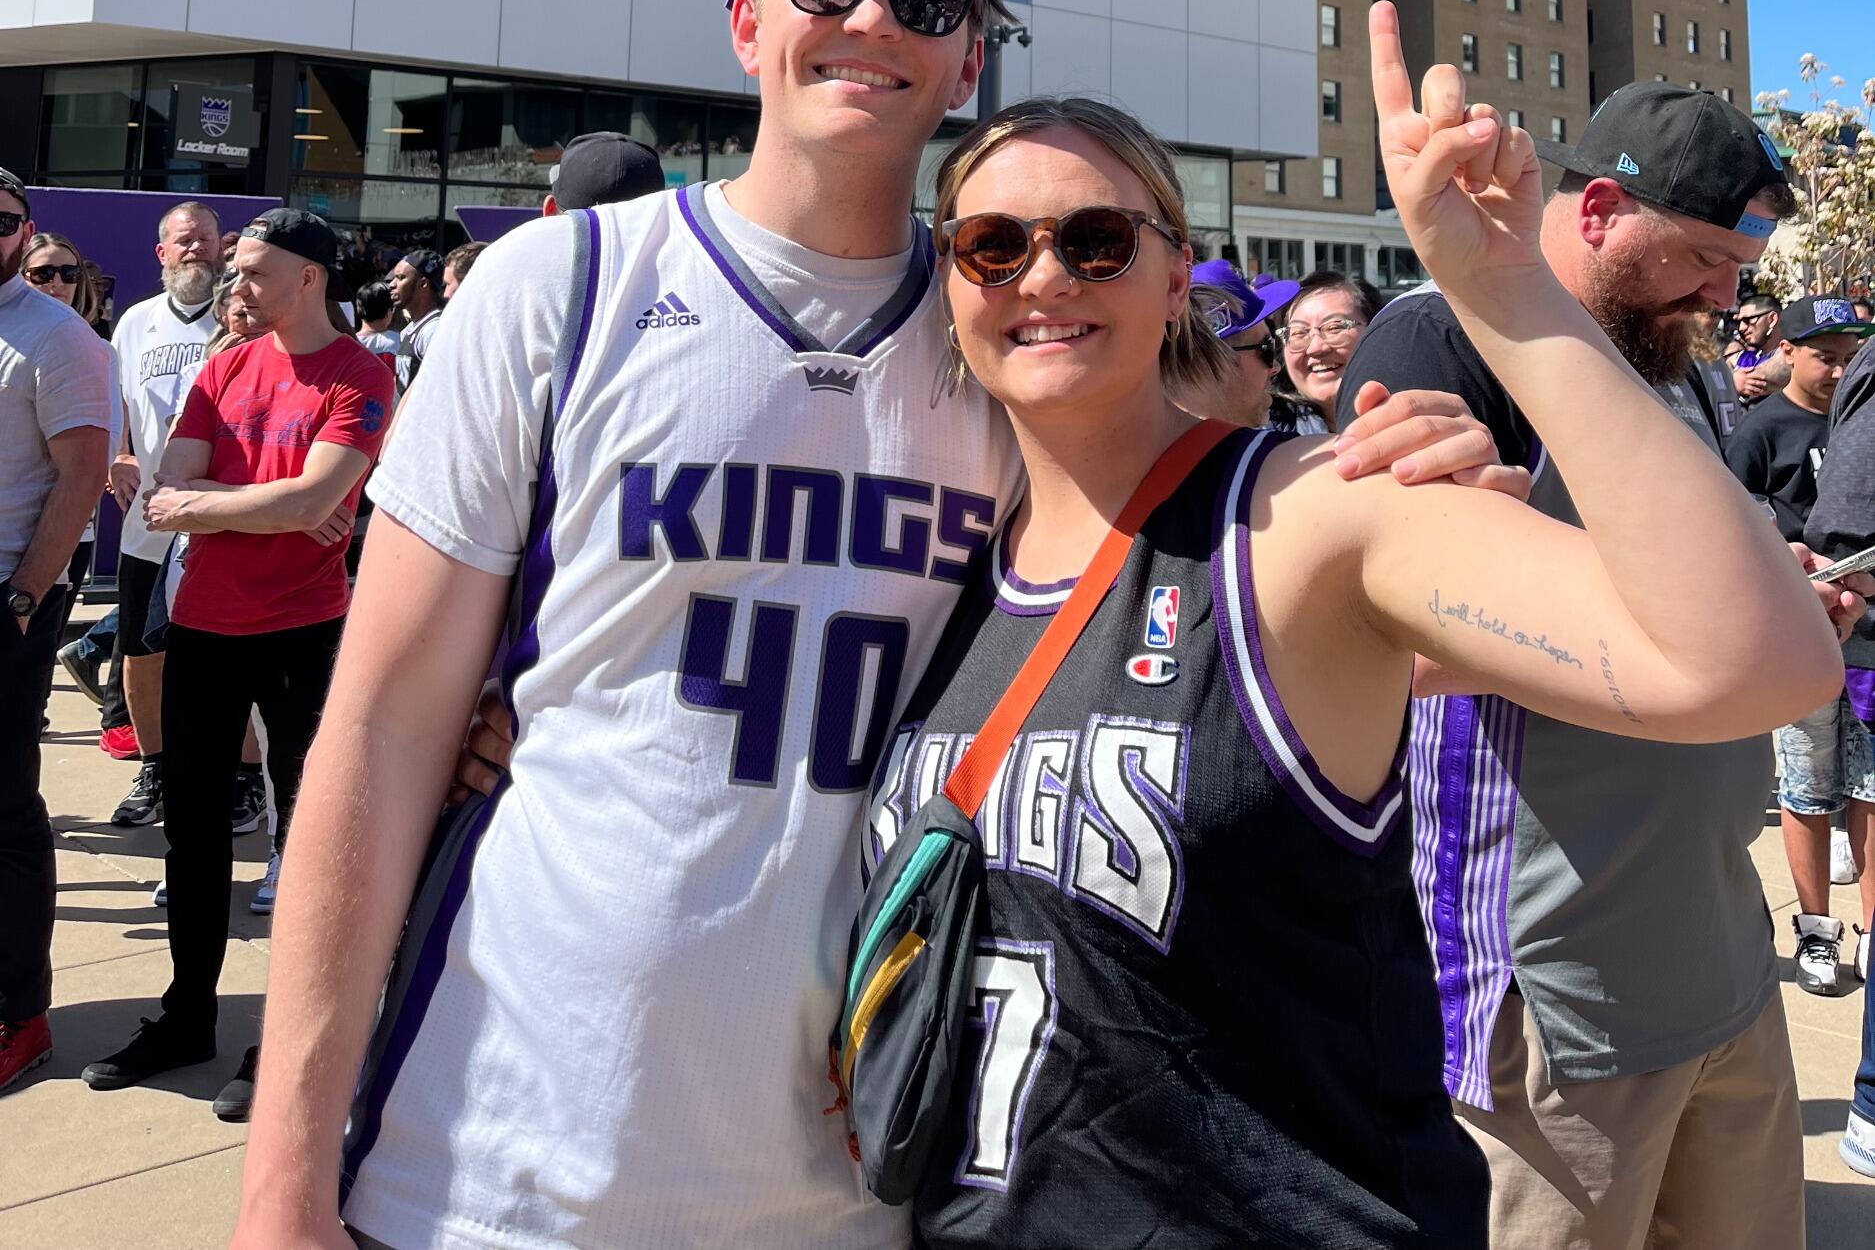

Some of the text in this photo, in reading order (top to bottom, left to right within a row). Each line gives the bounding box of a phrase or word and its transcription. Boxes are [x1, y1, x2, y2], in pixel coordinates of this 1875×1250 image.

[177, 139, 249, 157] Locker Room
[636, 312, 701, 330] adidas
[619, 462, 996, 585] KINGS
[1441, 603, 1474, 625] will
[1150, 634, 1167, 643] NBA
[675, 592, 910, 794] 40
[952, 936, 1059, 1193] 7
